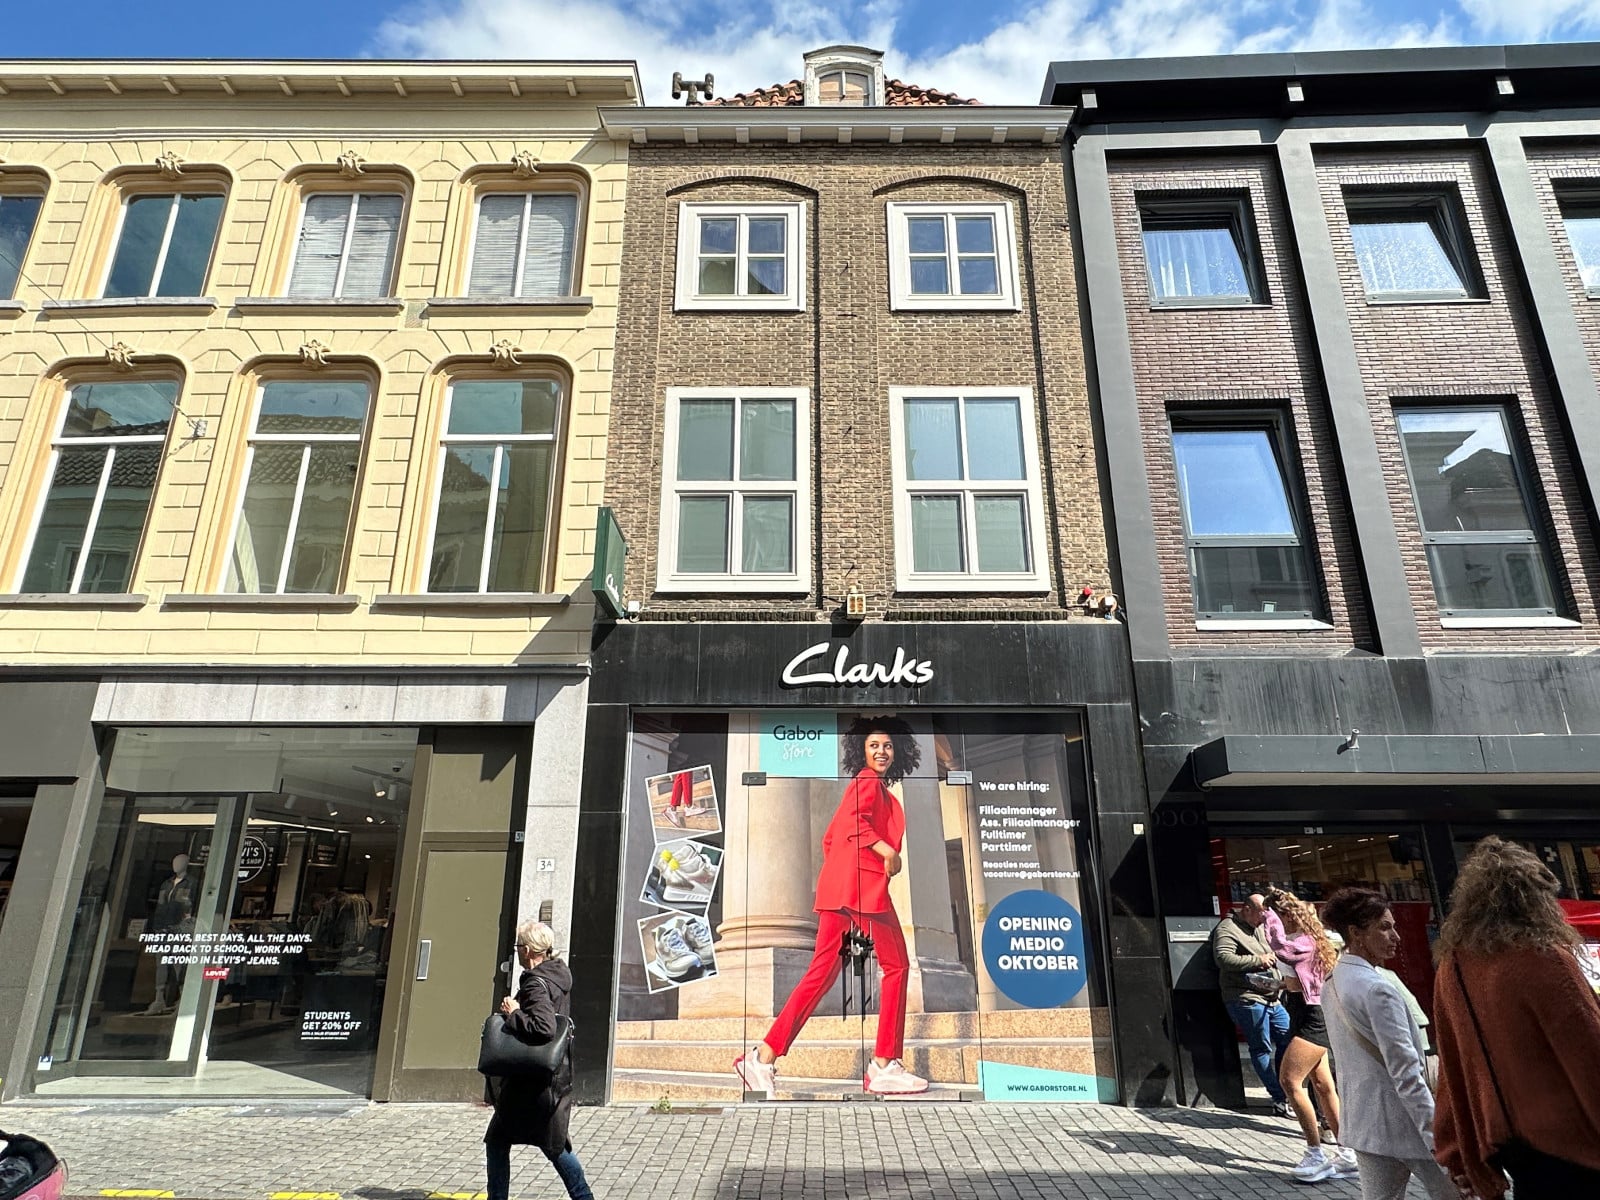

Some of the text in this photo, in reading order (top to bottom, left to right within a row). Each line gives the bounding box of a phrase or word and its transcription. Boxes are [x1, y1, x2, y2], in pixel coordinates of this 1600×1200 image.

[781, 642, 934, 685] Clarks
[773, 725, 824, 741] Gabor
[979, 781, 1050, 793] We are hiring:
[979, 805, 1057, 816] Filiaalmanager
[980, 818, 1080, 829] Ass. Filiaalmanager
[981, 830, 1026, 839] Fulltimer
[982, 842, 1032, 852] Parttimer
[540, 860, 552, 870] 3A
[983, 871, 1081, 879] vacature@gaborstore.nl
[999, 917, 1072, 931] OPENING
[139, 934, 312, 943] FIRST DAYS, BEST DAYS, ALL THE DAYS.
[1010, 937, 1064, 951] MEDIO
[145, 945, 303, 954] HEAD BACK TO SCHOOL, WORK AND
[161, 956, 199, 964] BEYOND
[200, 956, 210, 964] IN
[247, 956, 280, 965] JEANS.
[998, 955, 1079, 970] OKTOBER
[304, 1011, 351, 1020] STUDENTS
[302, 1021, 361, 1030] GET 20% OFF
